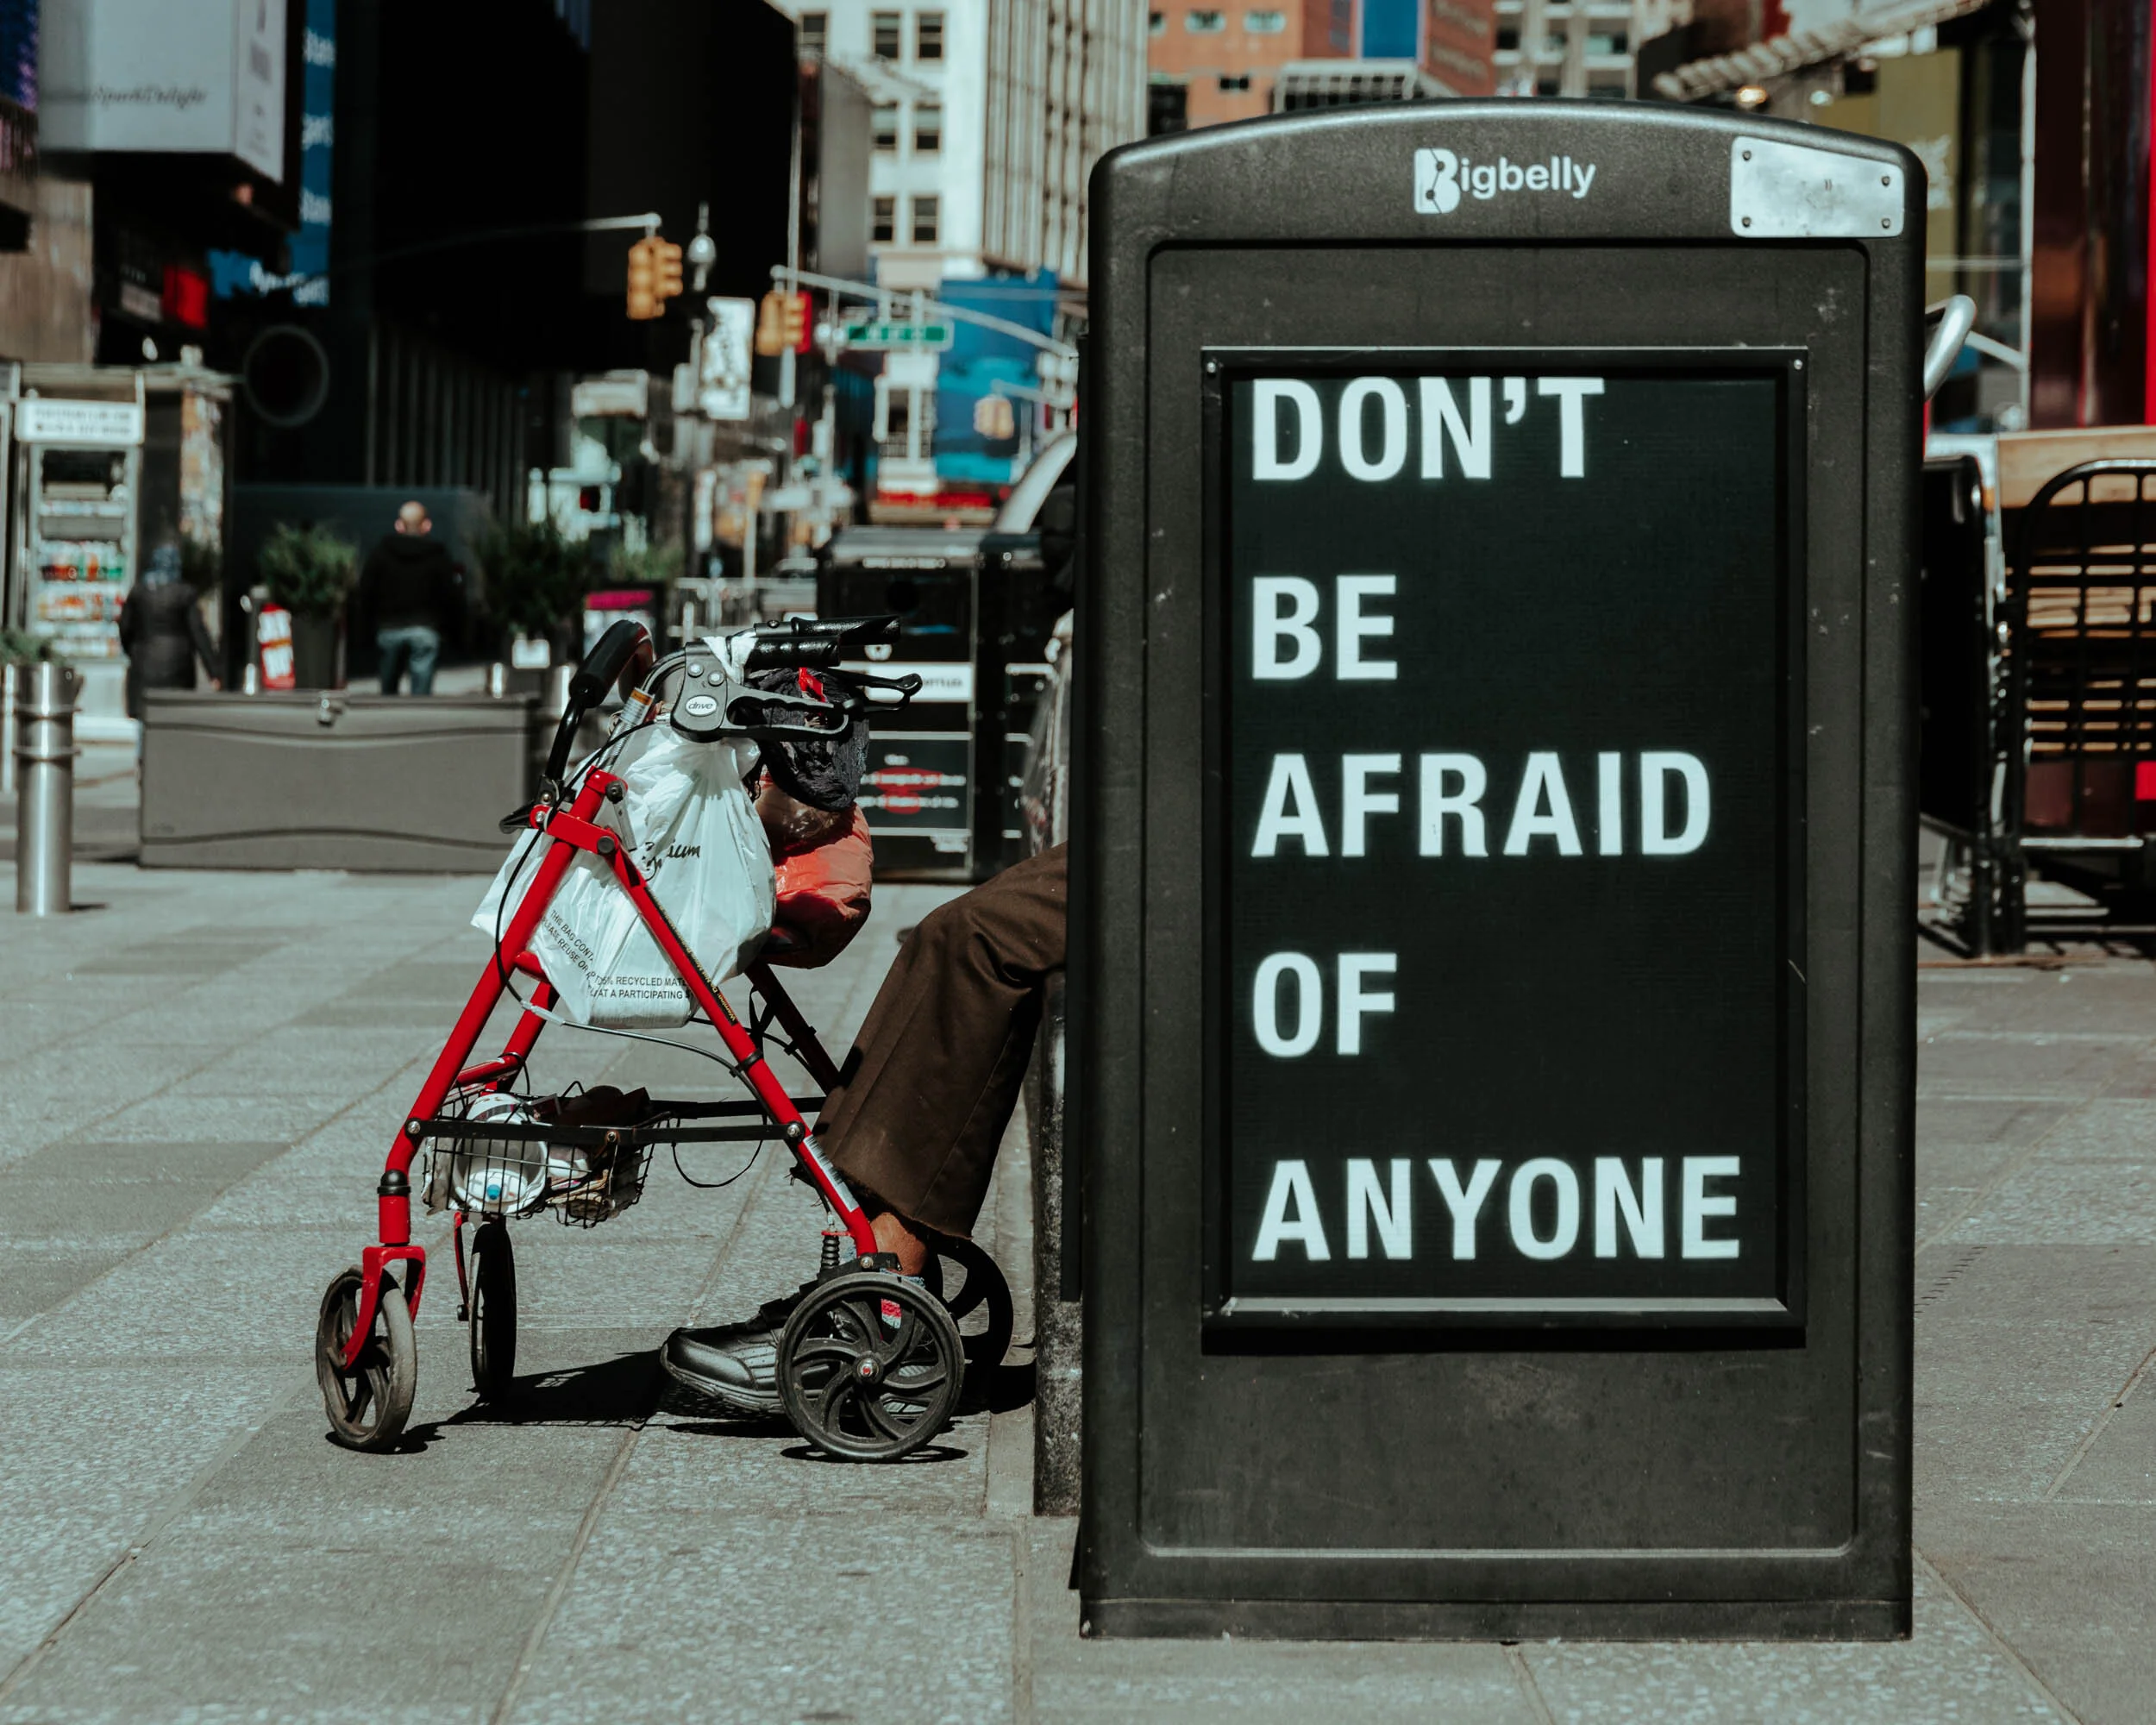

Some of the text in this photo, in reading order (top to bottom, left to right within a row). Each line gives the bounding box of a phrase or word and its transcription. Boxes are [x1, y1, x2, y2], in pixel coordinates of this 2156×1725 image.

[1413, 147, 1597, 215] Bigbelly
[1251, 376, 1606, 482] DON'T
[1251, 574, 1399, 681] BE
[688, 701, 714, 710] drive
[1250, 751, 1712, 857] AFRAID
[550, 909, 563, 925] THIS
[561, 924, 576, 941] BAG
[616, 976, 662, 986] RECYCLED
[557, 938, 580, 963] REUSE
[578, 960, 589, 973] OR
[598, 988, 609, 998] AT
[610, 989, 617, 998] A
[618, 989, 683, 1000] PARTICIPATING
[1251, 951, 1398, 1057] OF
[1251, 1156, 1740, 1261] ANYONE
